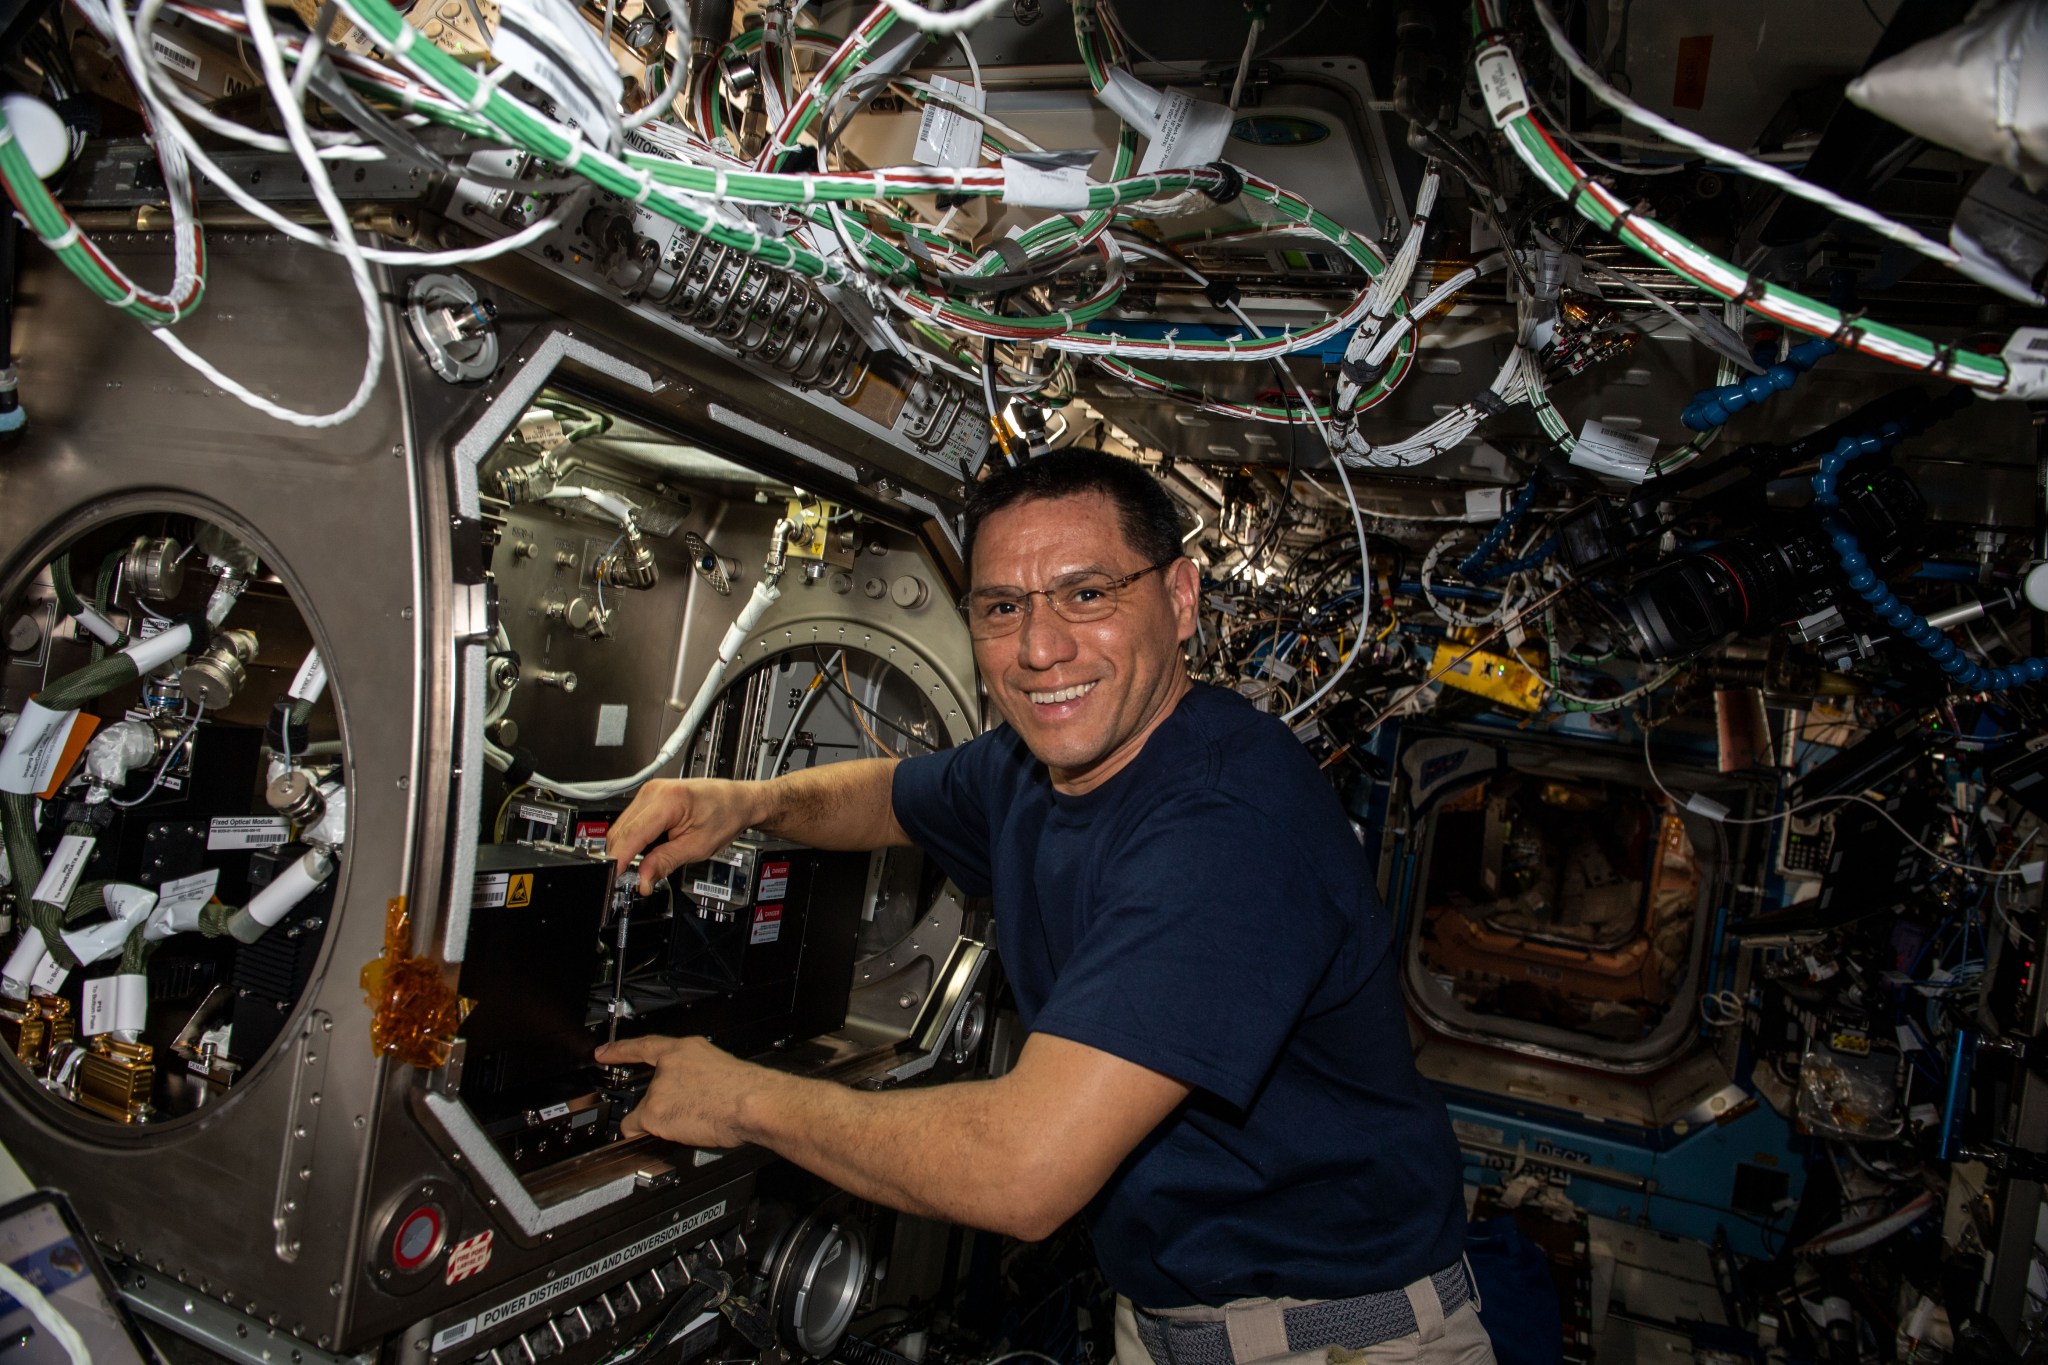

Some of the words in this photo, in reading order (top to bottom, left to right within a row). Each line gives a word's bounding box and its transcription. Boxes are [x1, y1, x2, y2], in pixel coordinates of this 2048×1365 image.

[1162, 120, 1170, 132] Load
[1880, 546, 1902, 564] Canon
[229, 818, 251, 826] Optical
[456, 1253, 470, 1263] FIRE
[471, 1245, 486, 1256] PORT
[483, 1298, 526, 1327] POWER
[528, 1264, 600, 1306] DISTRIBUTION
[601, 1253, 622, 1272] AND
[623, 1224, 681, 1260] CONVERSION
[681, 1215, 700, 1232] BOX
[700, 1205, 722, 1223] (PDC)
